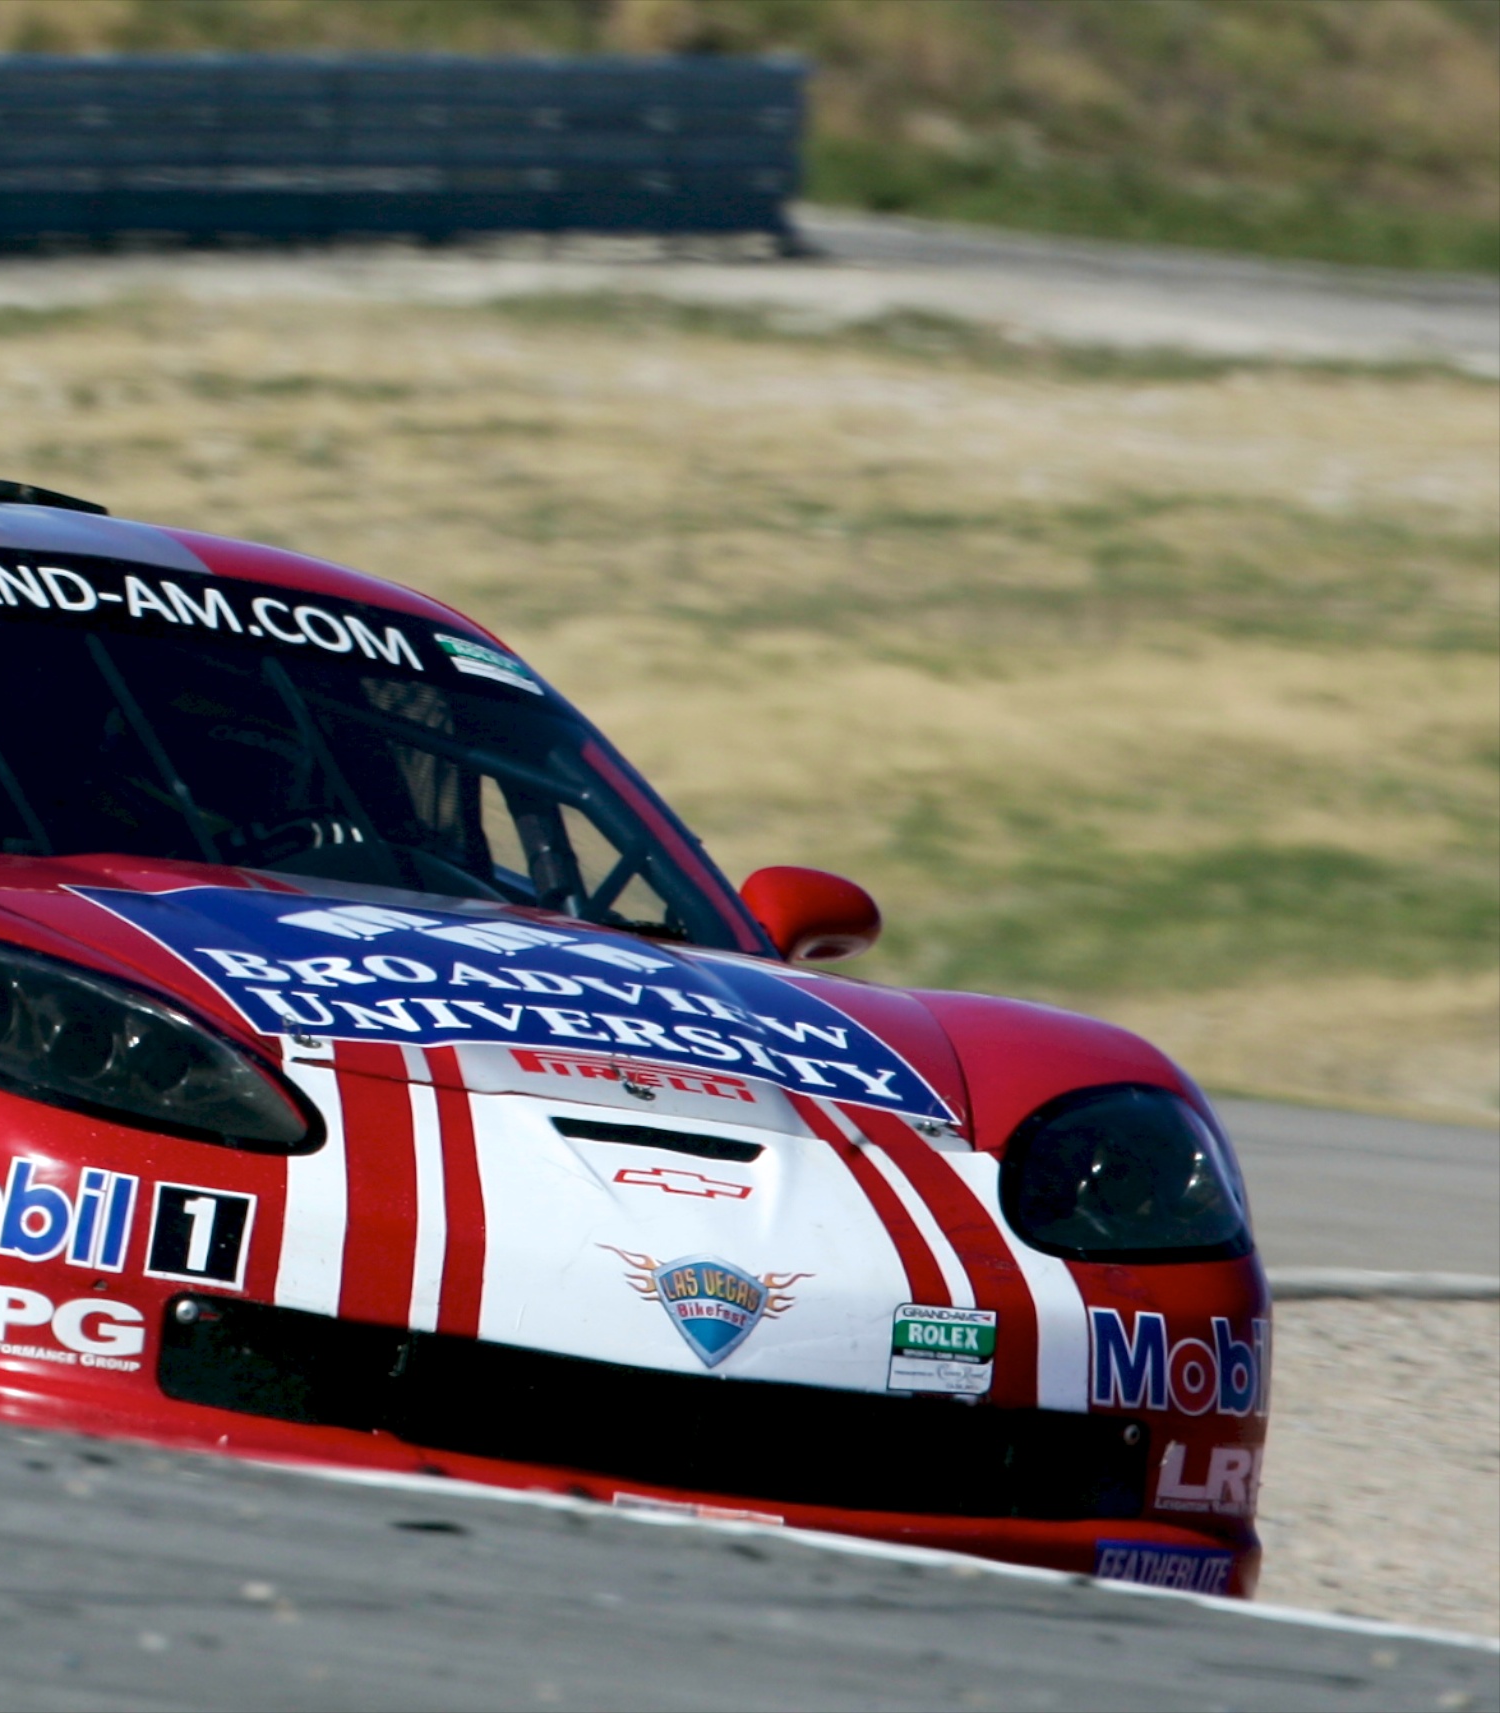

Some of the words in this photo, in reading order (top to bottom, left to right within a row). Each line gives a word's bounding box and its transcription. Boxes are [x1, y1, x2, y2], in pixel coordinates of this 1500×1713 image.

[194, 947, 850, 1050] BROADVIEW
[244, 987, 904, 1102] UNIVERSITY
[509, 1049, 757, 1103] PIRELLI
[661, 1268, 699, 1300] LAS
[702, 1268, 761, 1313] VEGAS
[676, 1302, 748, 1326] BikeFest
[908, 1322, 979, 1351] ROLEX
